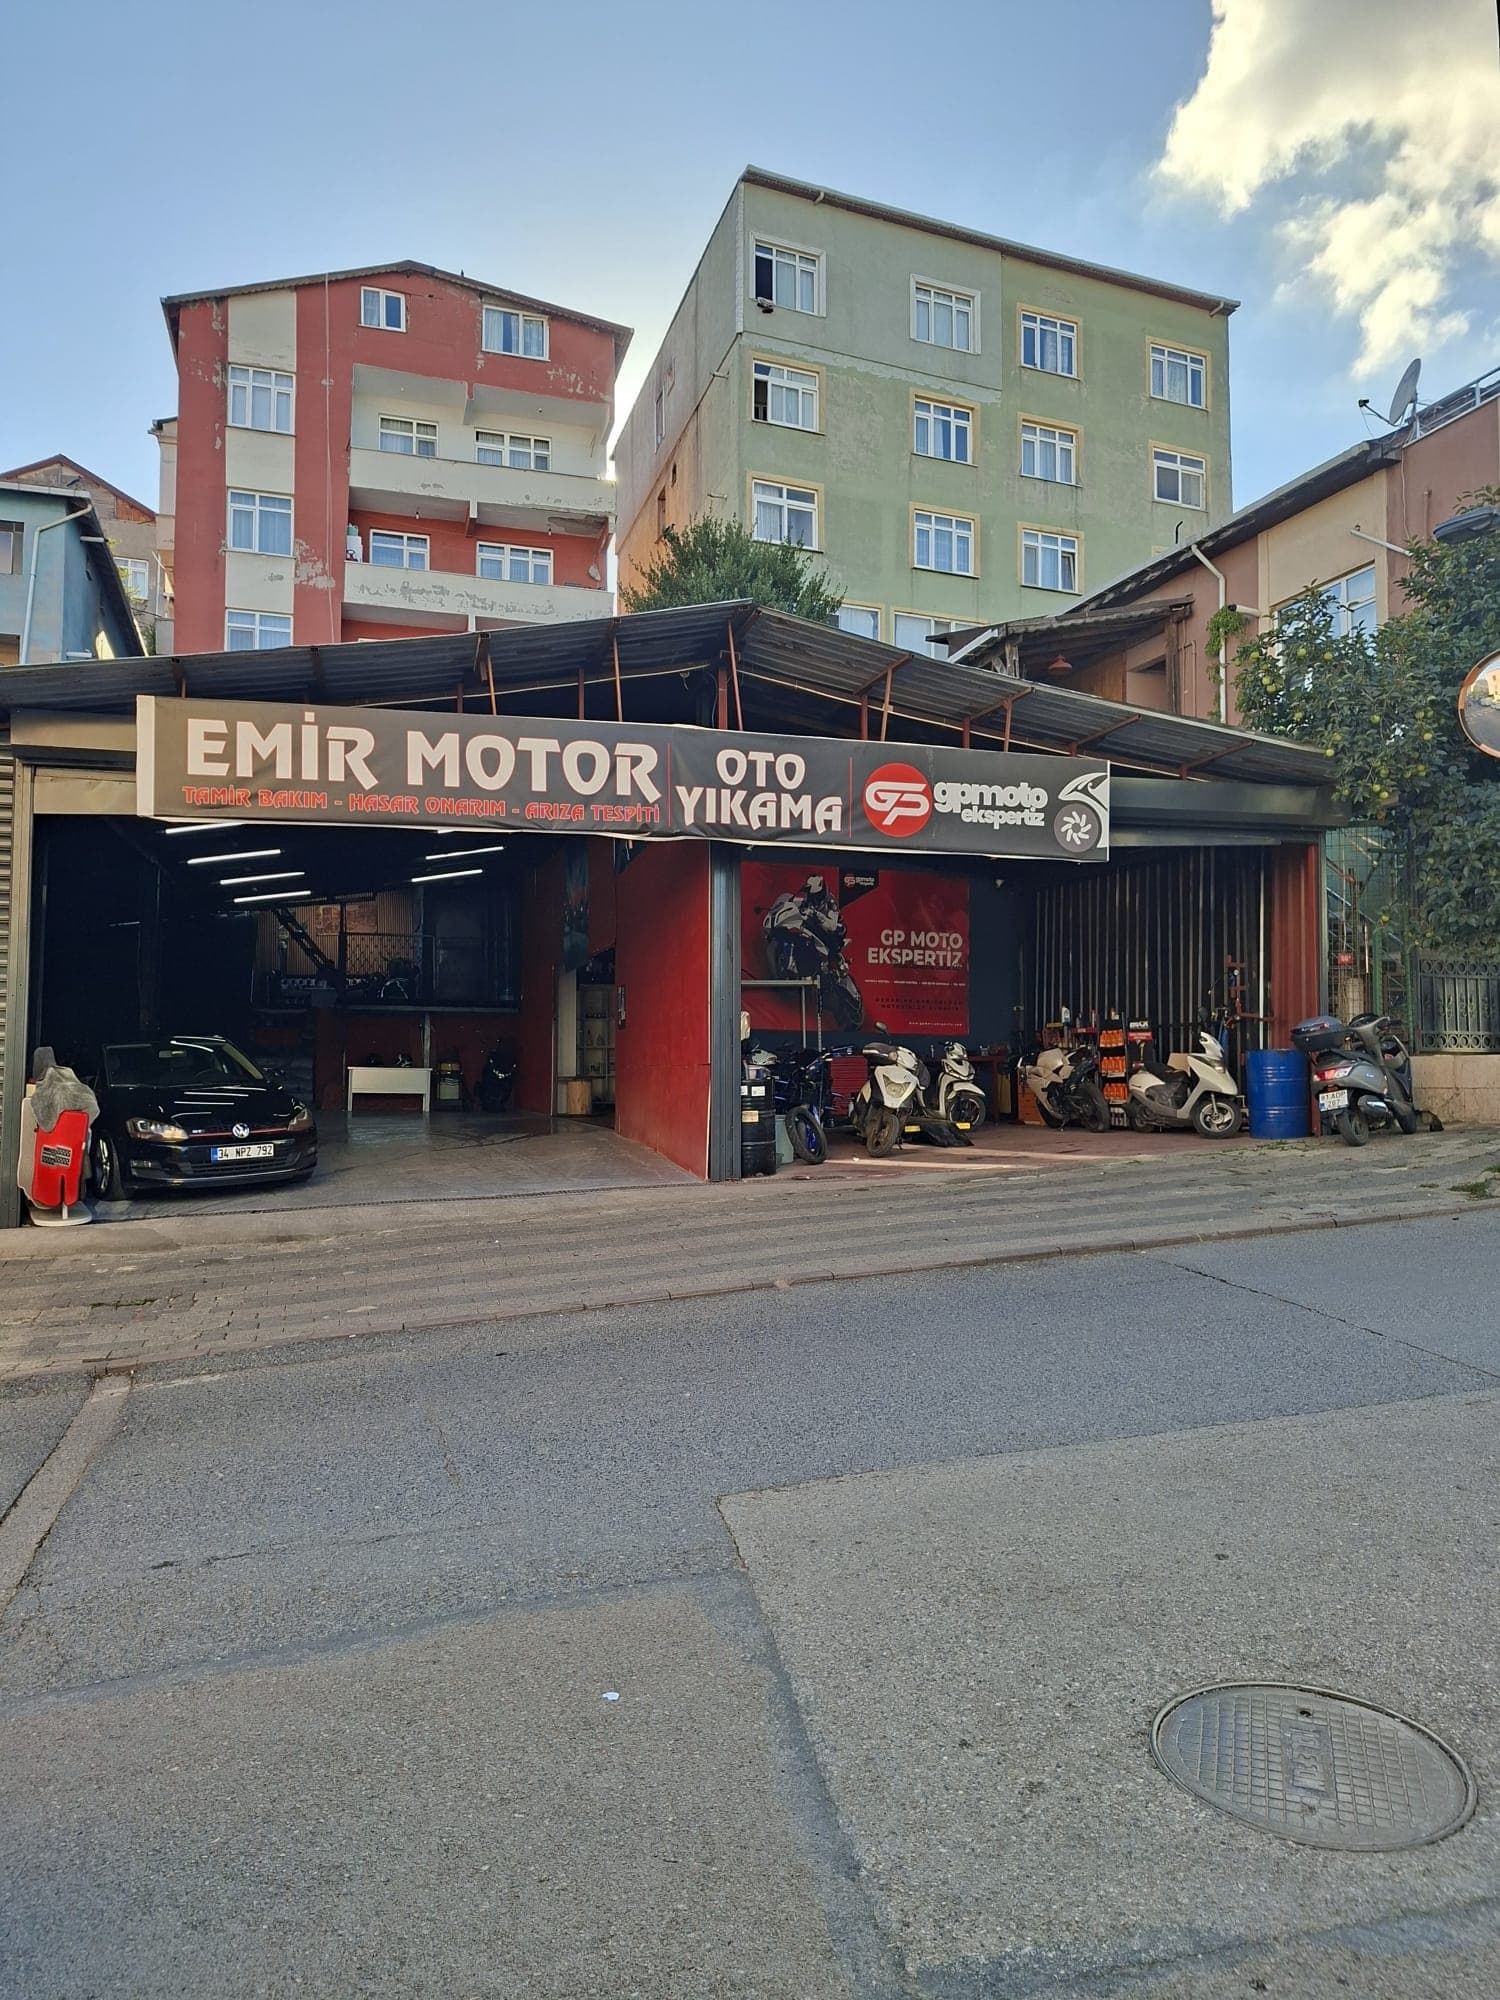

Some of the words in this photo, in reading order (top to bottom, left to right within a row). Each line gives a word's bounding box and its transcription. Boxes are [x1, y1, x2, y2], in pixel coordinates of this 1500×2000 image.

[186, 711, 379, 791] EMİR
[406, 730, 662, 803] MOTOR
[716, 749, 807, 788] OTO
[182, 784, 252, 807] TAMİR
[257, 789, 328, 809] BAKIM
[348, 792, 420, 814] HASAR
[425, 797, 507, 818] ONARIM
[524, 802, 585, 822] ARIZA
[590, 801, 660, 823] TESPİTİ
[675, 786, 843, 835] YIKAMA
[934, 781, 1048, 813] gpmoto
[960, 805, 1046, 829] ekspertiz
[880, 929, 906, 946] GP
[910, 930, 963, 949] MOTO
[867, 945, 963, 968] EKSPERTİZ
[218, 1149, 229, 1159] 34
[235, 1147, 251, 1157] NPZ
[256, 1145, 273, 1155] 792
